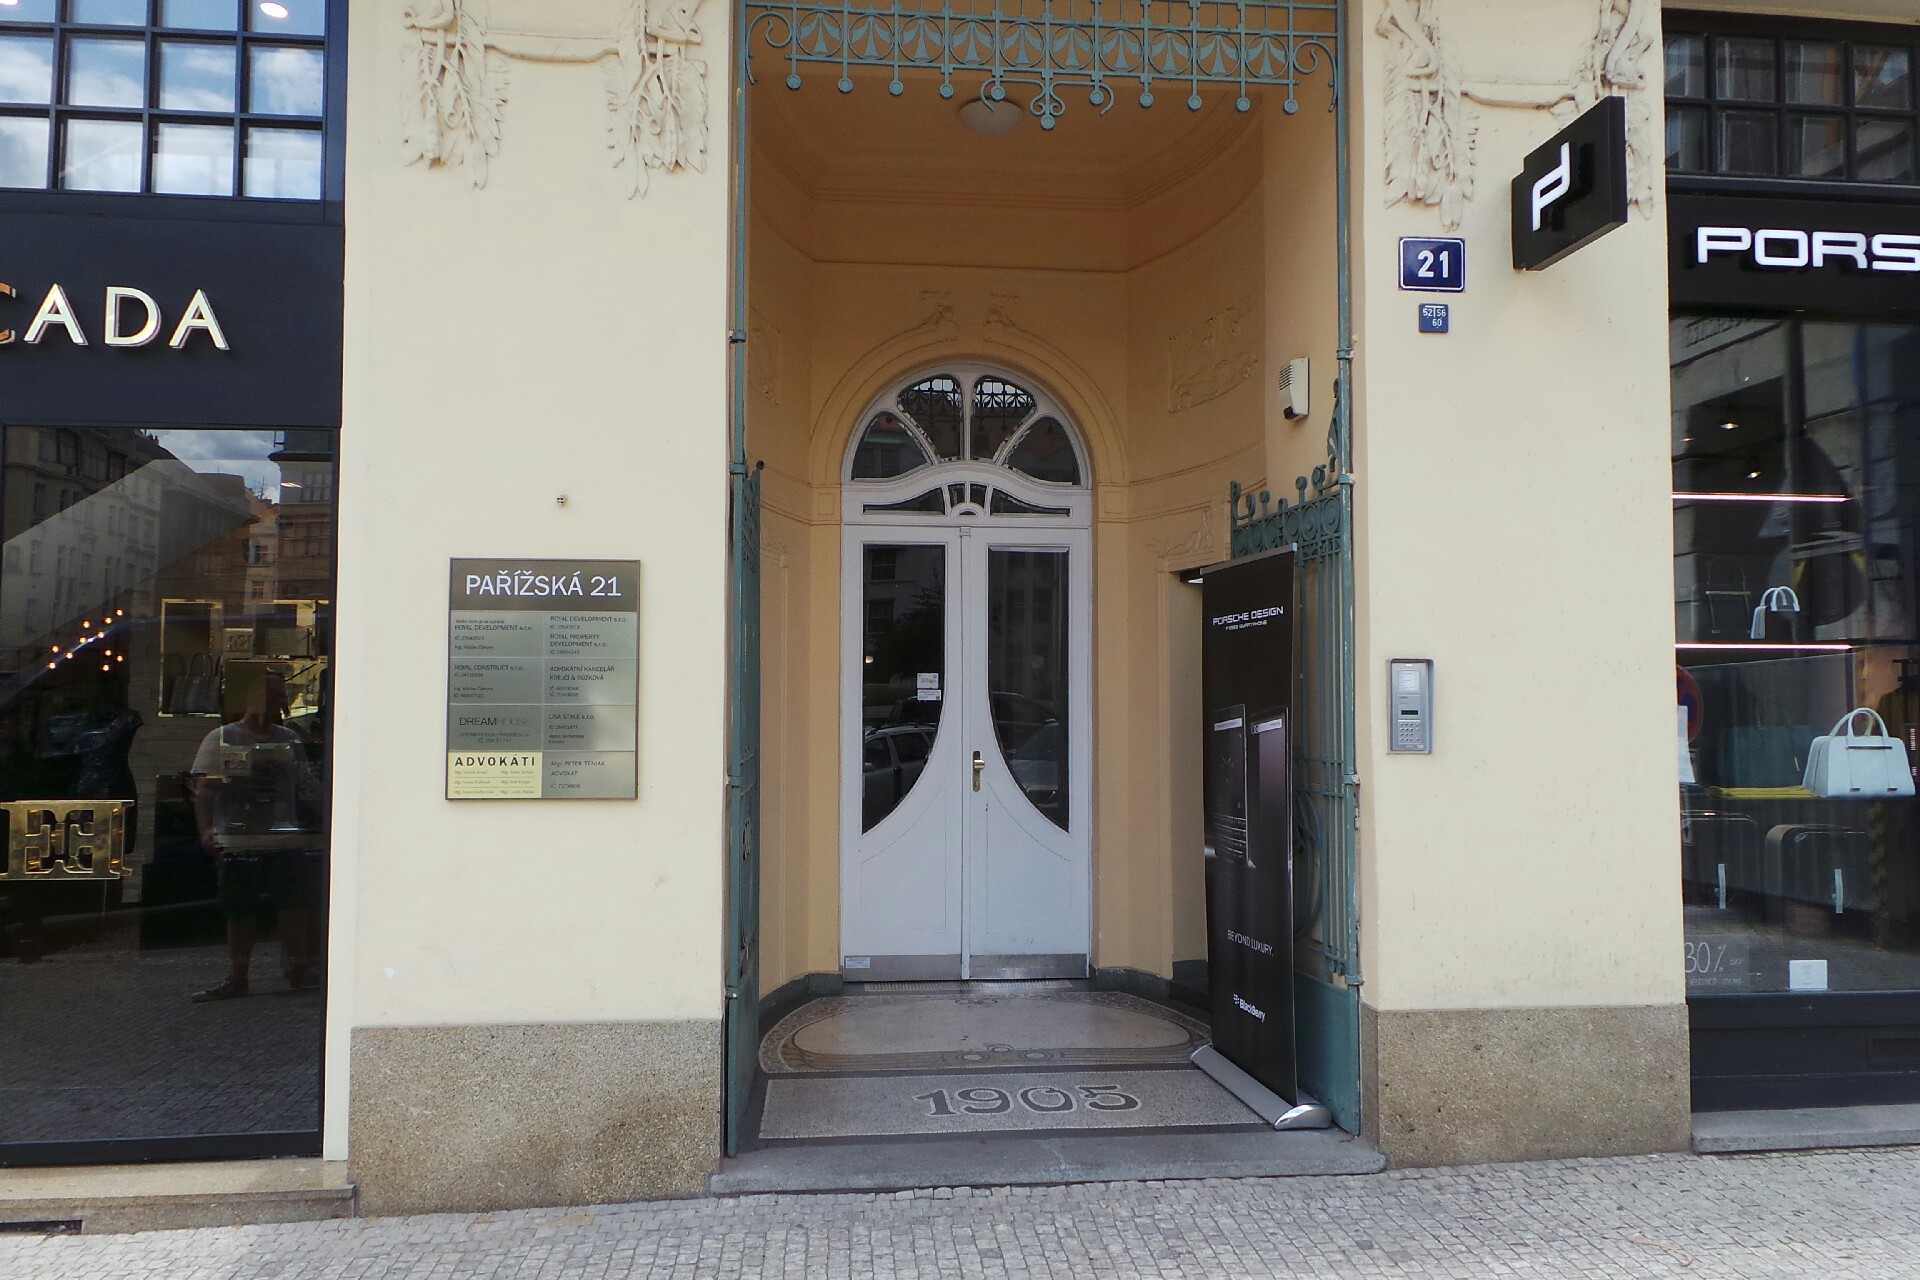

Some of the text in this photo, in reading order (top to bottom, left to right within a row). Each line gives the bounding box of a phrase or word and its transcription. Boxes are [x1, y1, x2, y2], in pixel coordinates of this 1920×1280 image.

[1417, 250, 1449, 278] 21
[465, 569, 622, 596] PAŘÍŽSKÁ 21
[1212, 605, 1284, 626] PORSCHE DESIGN
[454, 753, 535, 767] ADVOKÁTI
[1227, 929, 1251, 947] BEYOND
[1684, 941, 1728, 974] 30%
[1239, 998, 1266, 1023] BlackBerry
[913, 1084, 1142, 1117] 1905
